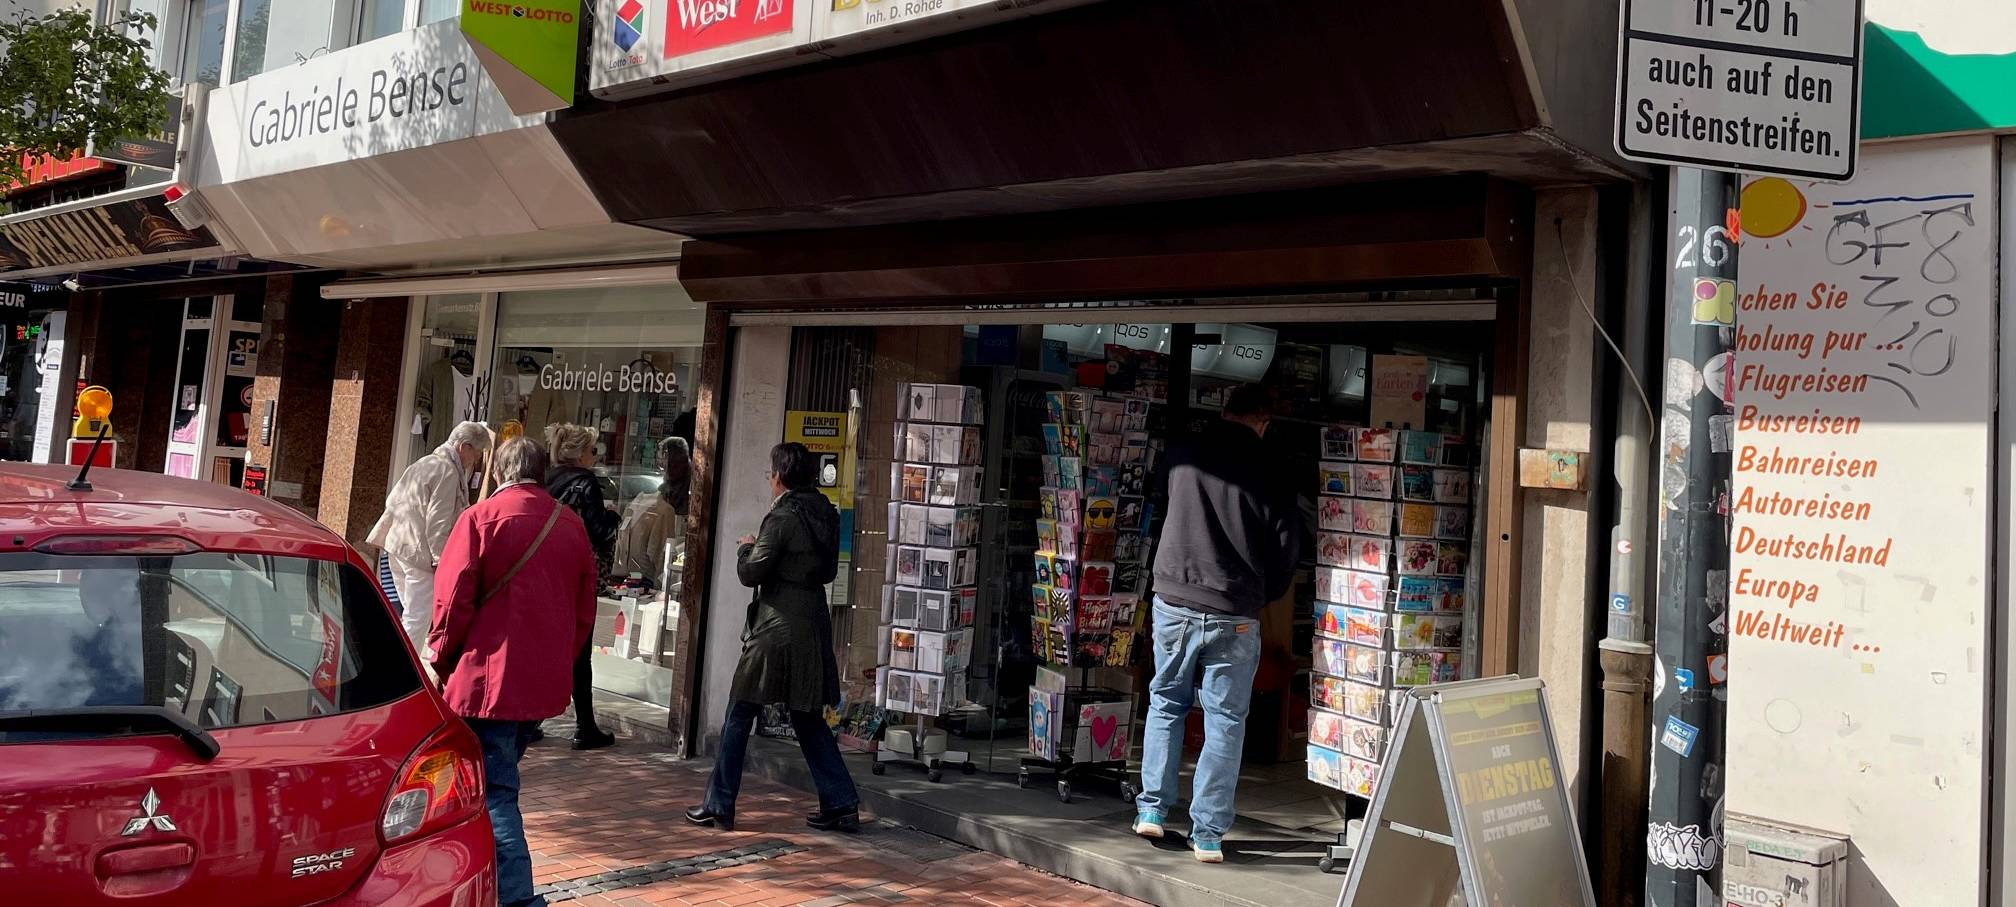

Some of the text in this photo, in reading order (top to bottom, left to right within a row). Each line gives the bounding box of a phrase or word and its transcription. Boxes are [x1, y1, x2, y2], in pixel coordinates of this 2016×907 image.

[470, 0, 573, 24] WEST LOTTO
[676, 0, 737, 30] West
[866, 0, 943, 25] Inh. D. Rohde
[1693, 0, 1798, 37] 11-20 h
[609, 58, 627, 69] Lotto
[1648, 54, 1833, 104] auch auf den
[249, 61, 467, 148] Gabriele Bense
[1635, 98, 1840, 157] Seitenstreifen.
[1675, 224, 1730, 270] 26
[1806, 282, 1848, 310] Sie
[1232, 344, 1263, 360] IQOS
[1822, 330, 1867, 359] pur
[540, 361, 677, 394] Gabriele Bense
[1738, 364, 1869, 400] Flugreisen
[803, 415, 840, 426] JACKPOT
[1738, 404, 1861, 435] Busreisen
[1737, 445, 1878, 479] Bahnreisen
[1734, 486, 1871, 521] Autoreisen
[1735, 526, 1893, 568] Deutschland
[1612, 597, 1625, 610] G
[1735, 568, 1819, 608] Europa
[1735, 610, 1845, 649] Weltweit
[1458, 756, 1554, 806] DIENSTAG
[291, 860, 343, 879] STAR
[292, 847, 356, 868] SPACE
